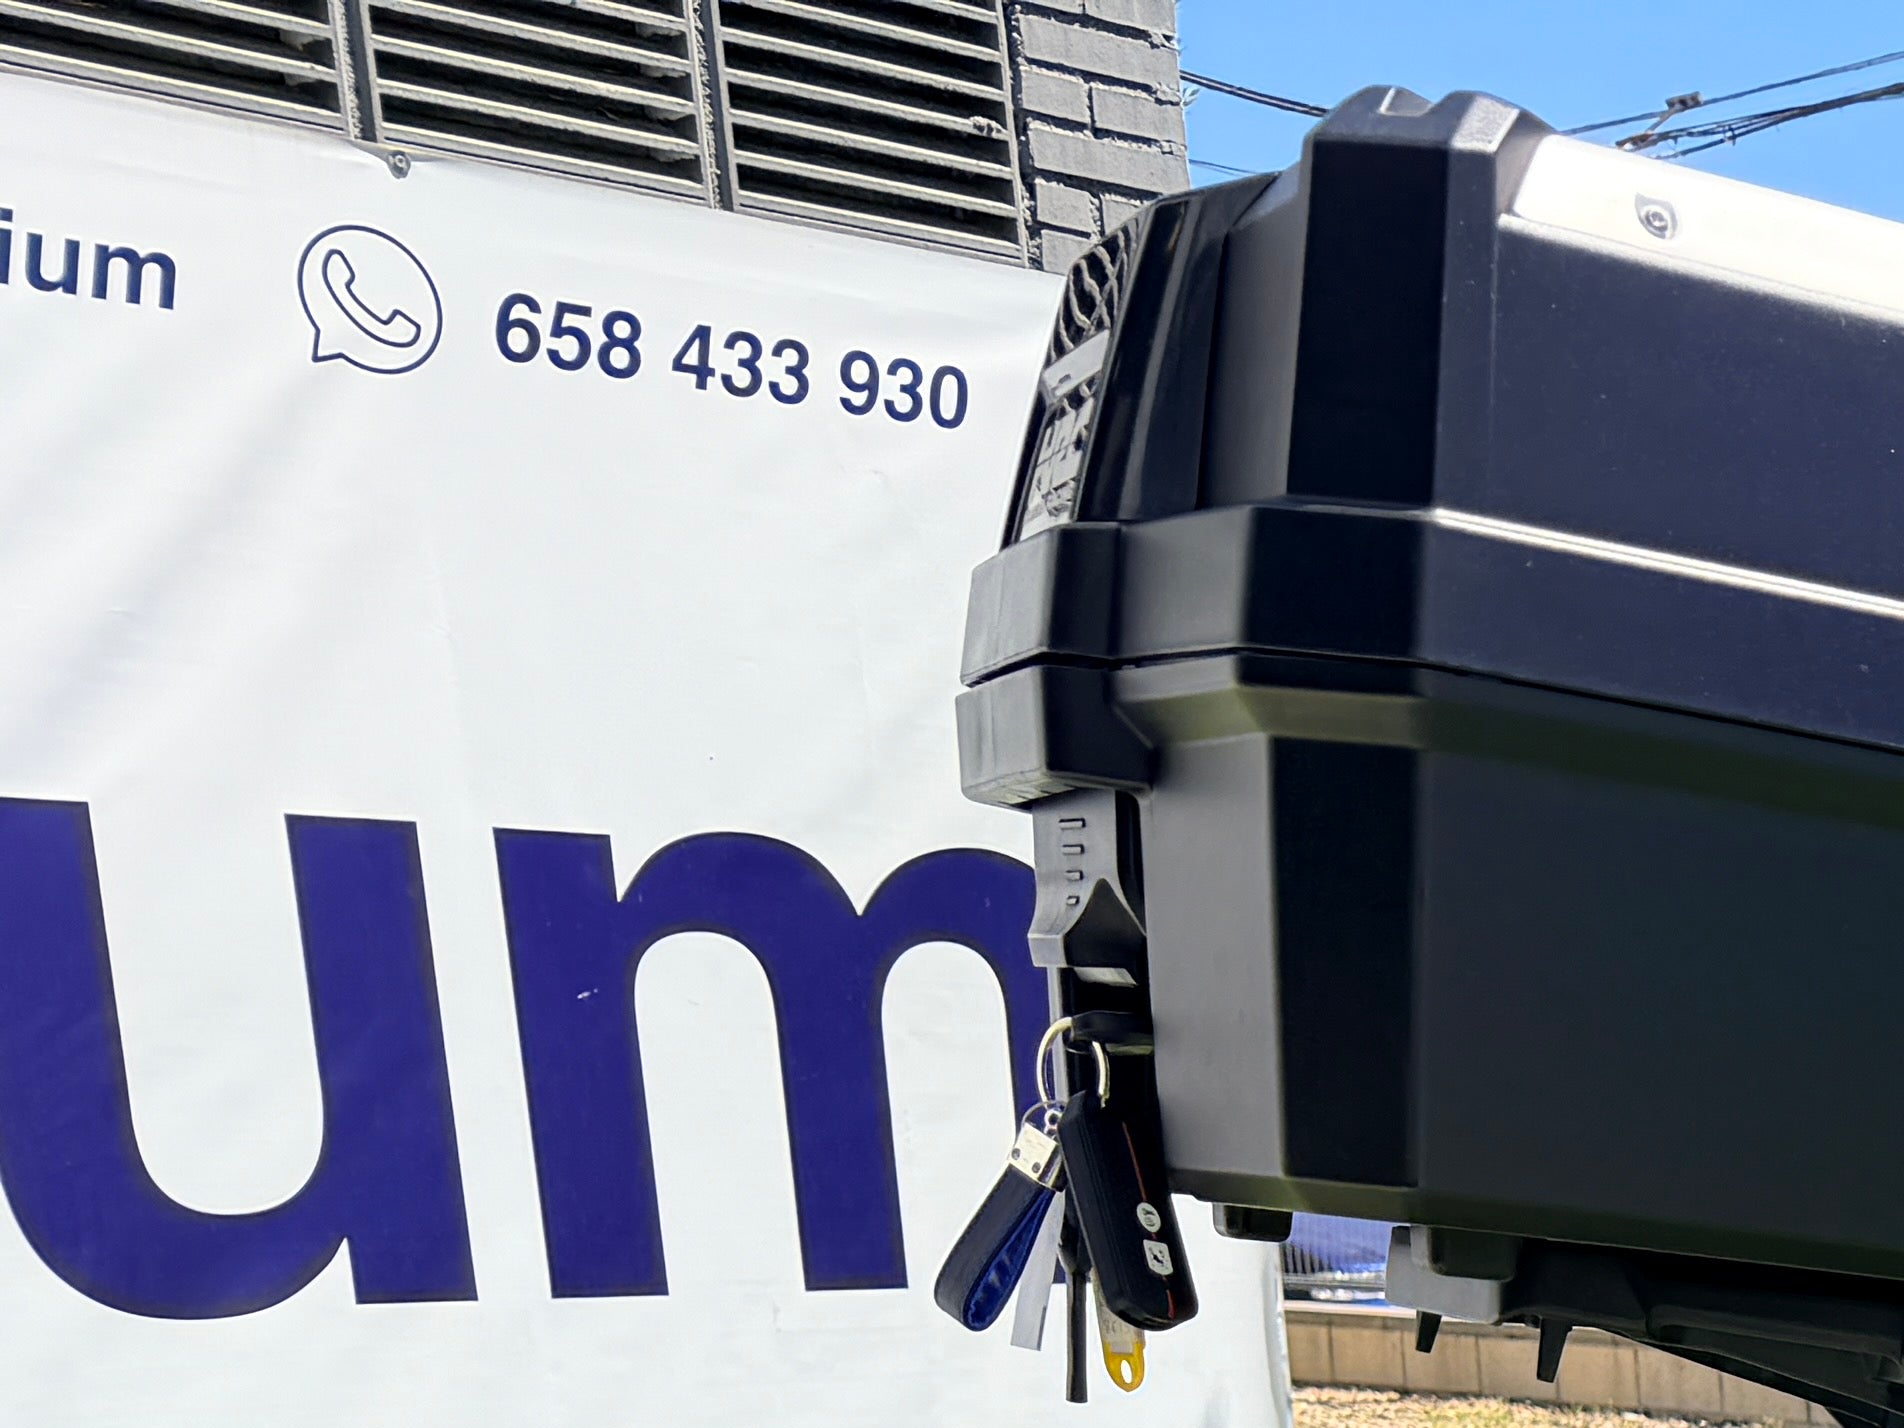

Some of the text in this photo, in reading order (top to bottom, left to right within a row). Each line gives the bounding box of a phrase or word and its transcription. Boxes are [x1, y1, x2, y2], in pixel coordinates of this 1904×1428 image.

[495, 292, 968, 429] 658 433 930
